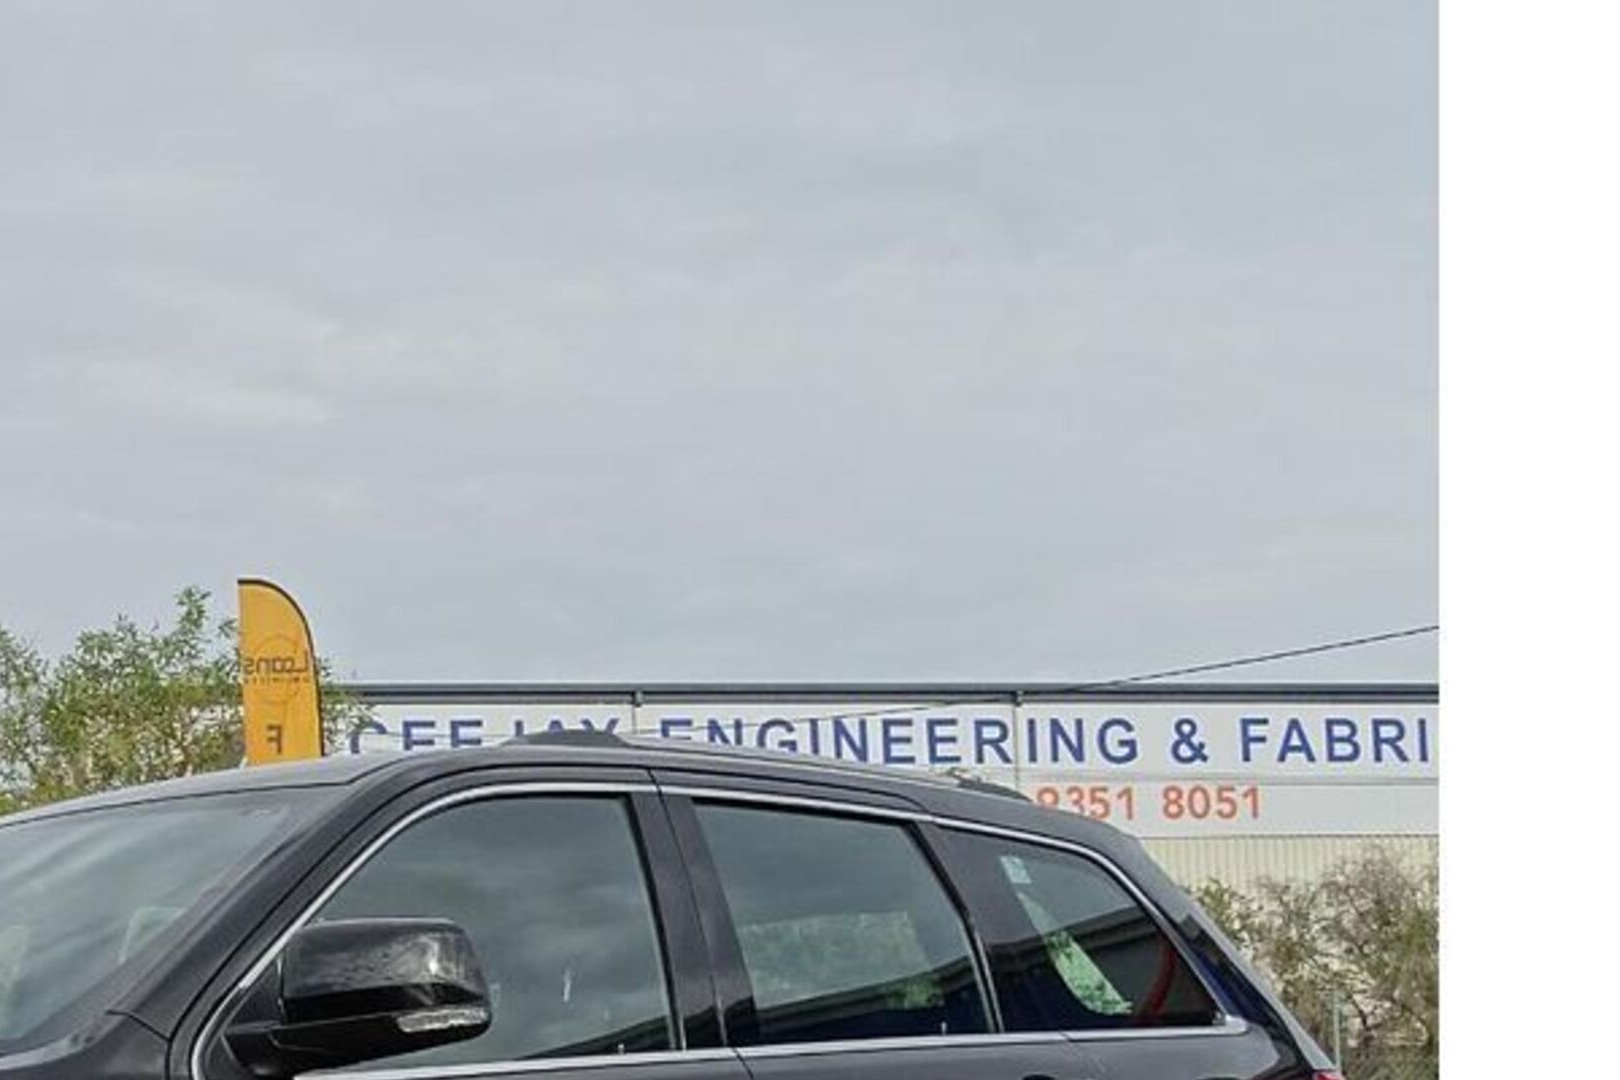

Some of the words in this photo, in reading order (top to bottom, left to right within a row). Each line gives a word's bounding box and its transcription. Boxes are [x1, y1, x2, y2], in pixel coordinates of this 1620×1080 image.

[1170, 717, 1209, 764] &
[1240, 717, 1429, 764] FABRI
[1162, 784, 1260, 820] 8051
